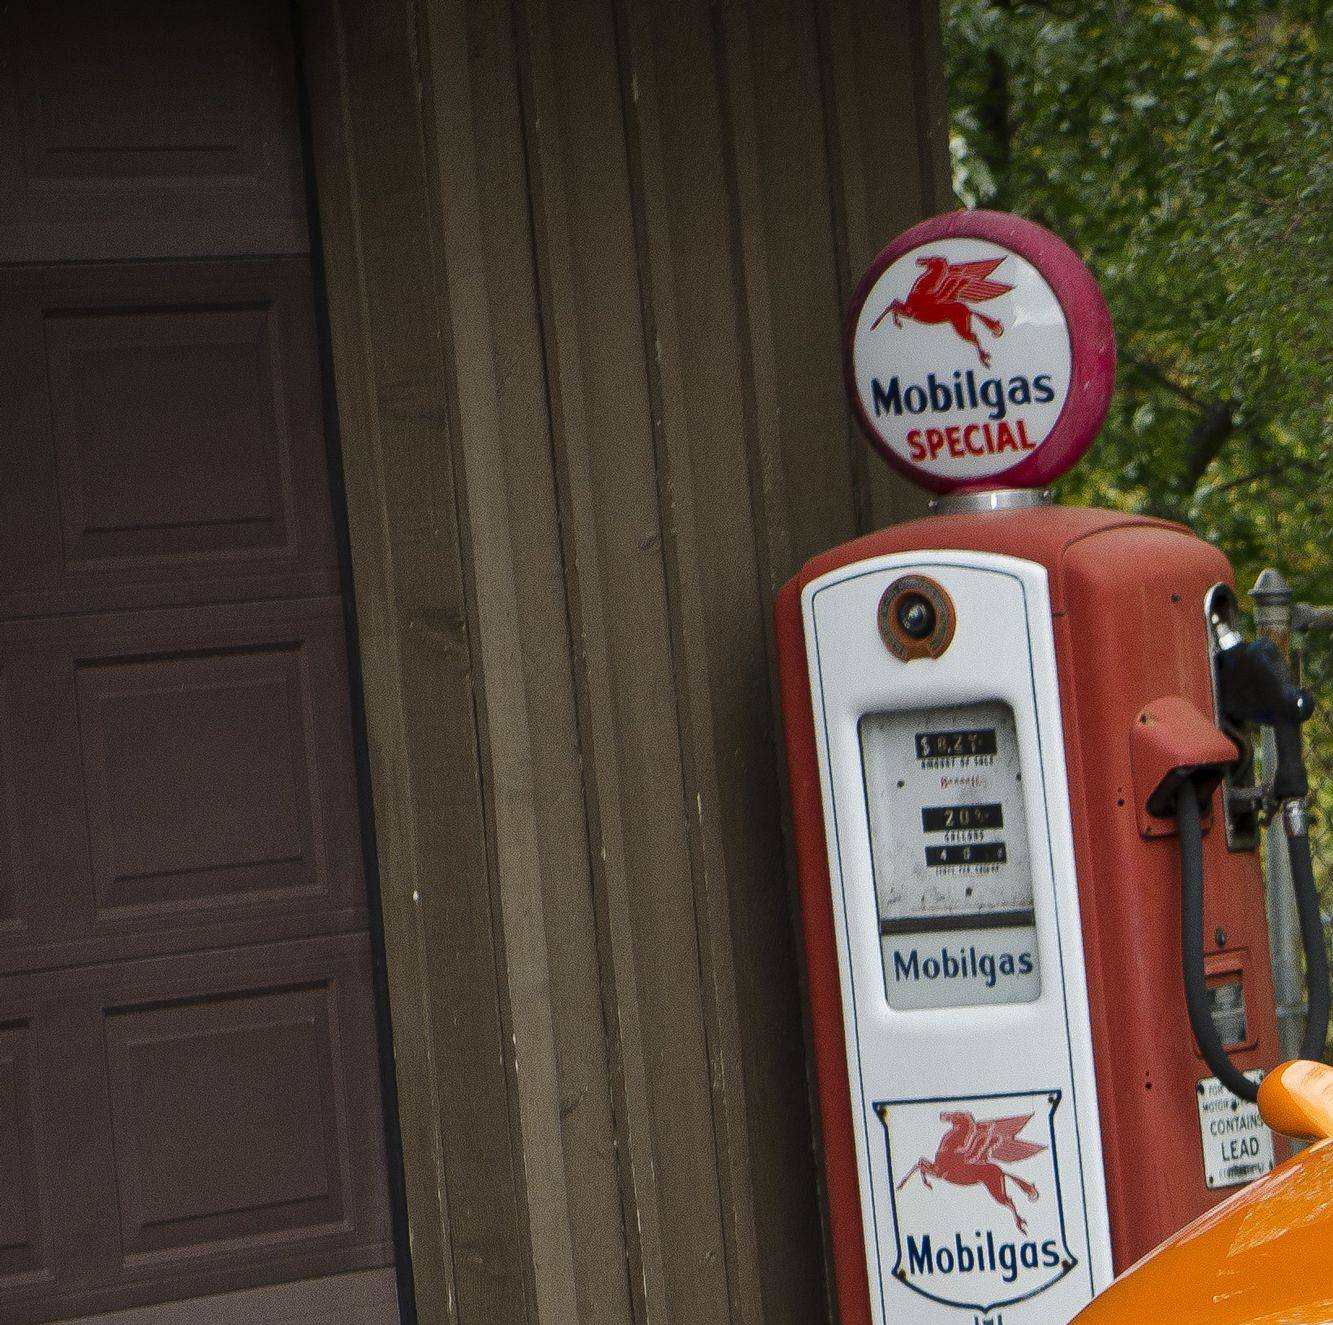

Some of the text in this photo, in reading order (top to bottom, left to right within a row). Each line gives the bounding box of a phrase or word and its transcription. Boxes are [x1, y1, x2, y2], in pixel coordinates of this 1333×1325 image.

[871, 369, 1056, 421] Mobilgas
[906, 418, 1036, 463] SPECIAL
[893, 946, 1034, 988] Mobilgas
[1221, 1137, 1260, 1161] LEAD
[906, 1230, 1060, 1283] Mobilgas
